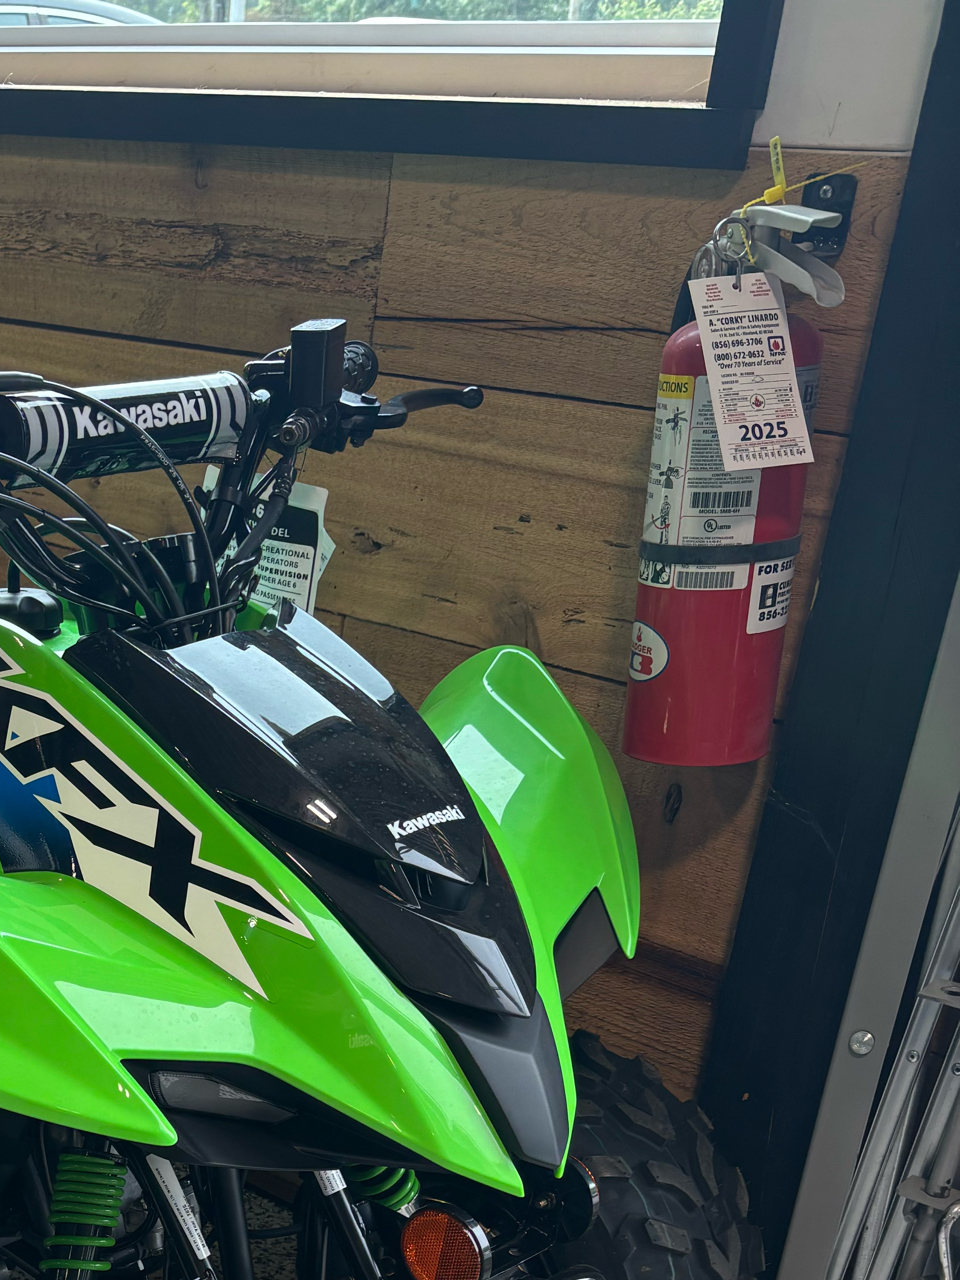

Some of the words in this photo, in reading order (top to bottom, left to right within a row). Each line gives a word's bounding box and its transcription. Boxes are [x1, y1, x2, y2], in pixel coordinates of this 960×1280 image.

[748, 313, 779, 323] LINARDO
[712, 339, 730, 350] (856)
[731, 338, 763, 347] 696-3706
[714, 352, 732, 362] (800)
[733, 350, 764, 359] 672-0632
[739, 421, 788, 441] 2025
[262, 544, 310, 560] CREATIONAL
[260, 556, 298, 568] PERATORS
[758, 564, 779, 575] FOR
[277, 578, 291, 588] AGE
[386, 805, 465, 840] Kawasaki
